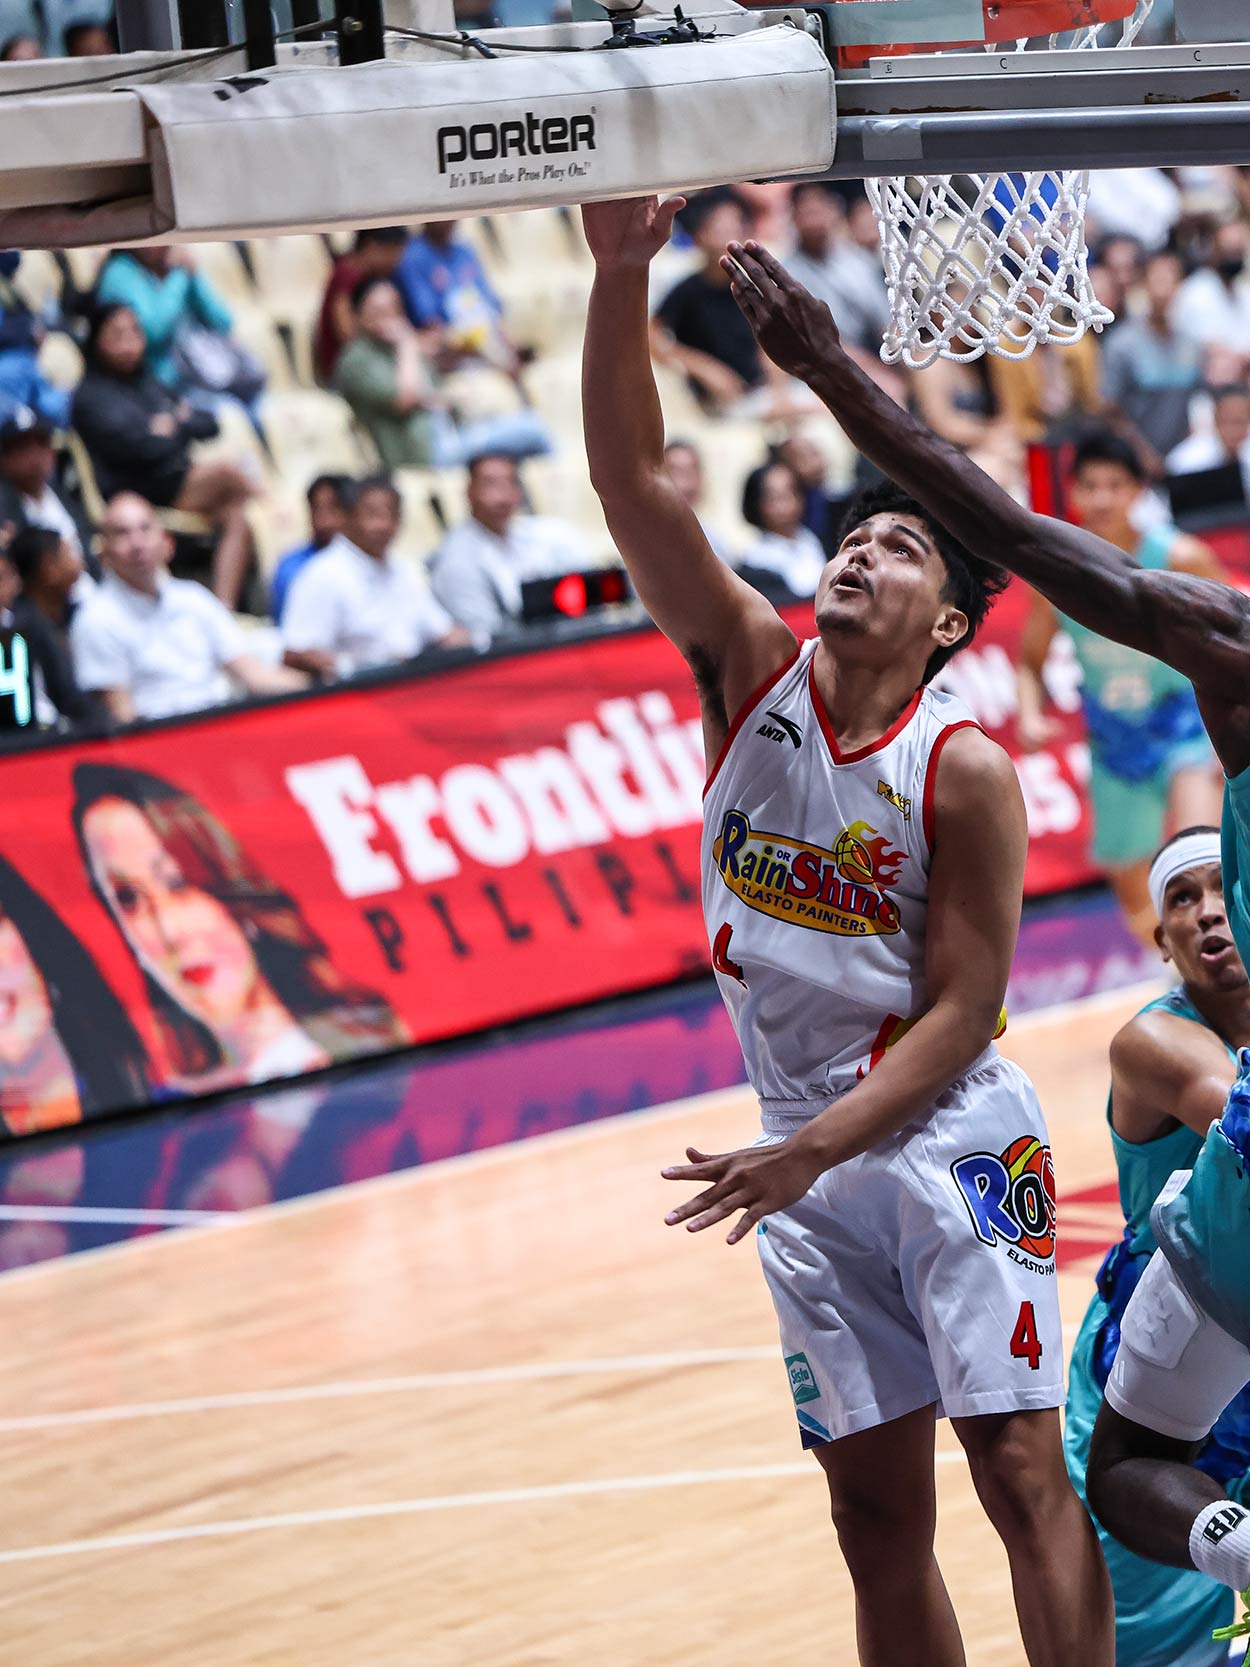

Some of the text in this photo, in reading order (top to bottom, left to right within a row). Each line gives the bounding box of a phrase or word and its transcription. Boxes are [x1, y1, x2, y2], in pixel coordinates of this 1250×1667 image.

[469, 170, 496, 186] What
[498, 168, 514, 184] the
[516, 165, 541, 182] Pros
[542, 163, 566, 182] Play
[756, 724, 787, 744] ANTA
[719, 809, 898, 929] Rain OR Shine
[741, 884, 867, 934] ELASTO PAINTERS
[1007, 1248, 1045, 1275] ELASTO
[1009, 1300, 1042, 1370] 4
